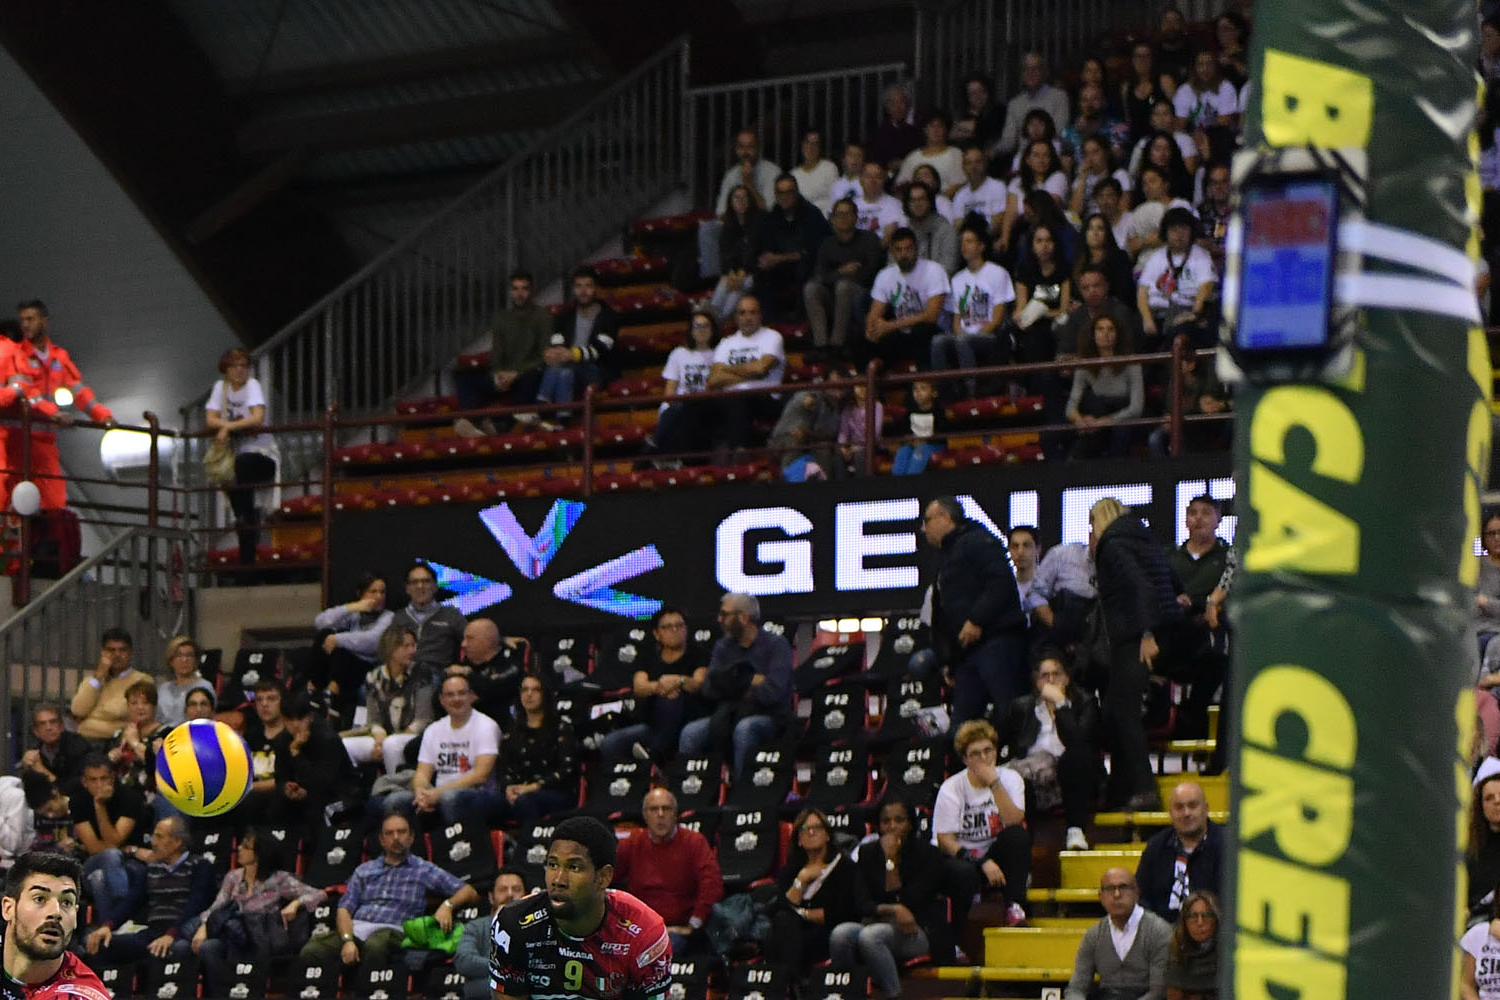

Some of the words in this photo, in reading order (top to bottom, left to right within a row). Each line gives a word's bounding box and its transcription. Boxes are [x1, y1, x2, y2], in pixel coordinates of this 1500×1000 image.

[1244, 48, 1374, 576] BCA
[824, 693, 849, 705] F12
[755, 751, 781, 763] E12
[829, 750, 853, 763] E13
[906, 748, 931, 763] E14
[686, 759, 709, 771] E11
[735, 812, 762, 825] D13
[334, 829, 352, 841] D7
[444, 823, 464, 839] D9
[164, 963, 181, 975] B7
[305, 967, 323, 979] B9
[563, 959, 584, 991] 9
[670, 962, 695, 975] B14
[370, 969, 394, 983] B10
